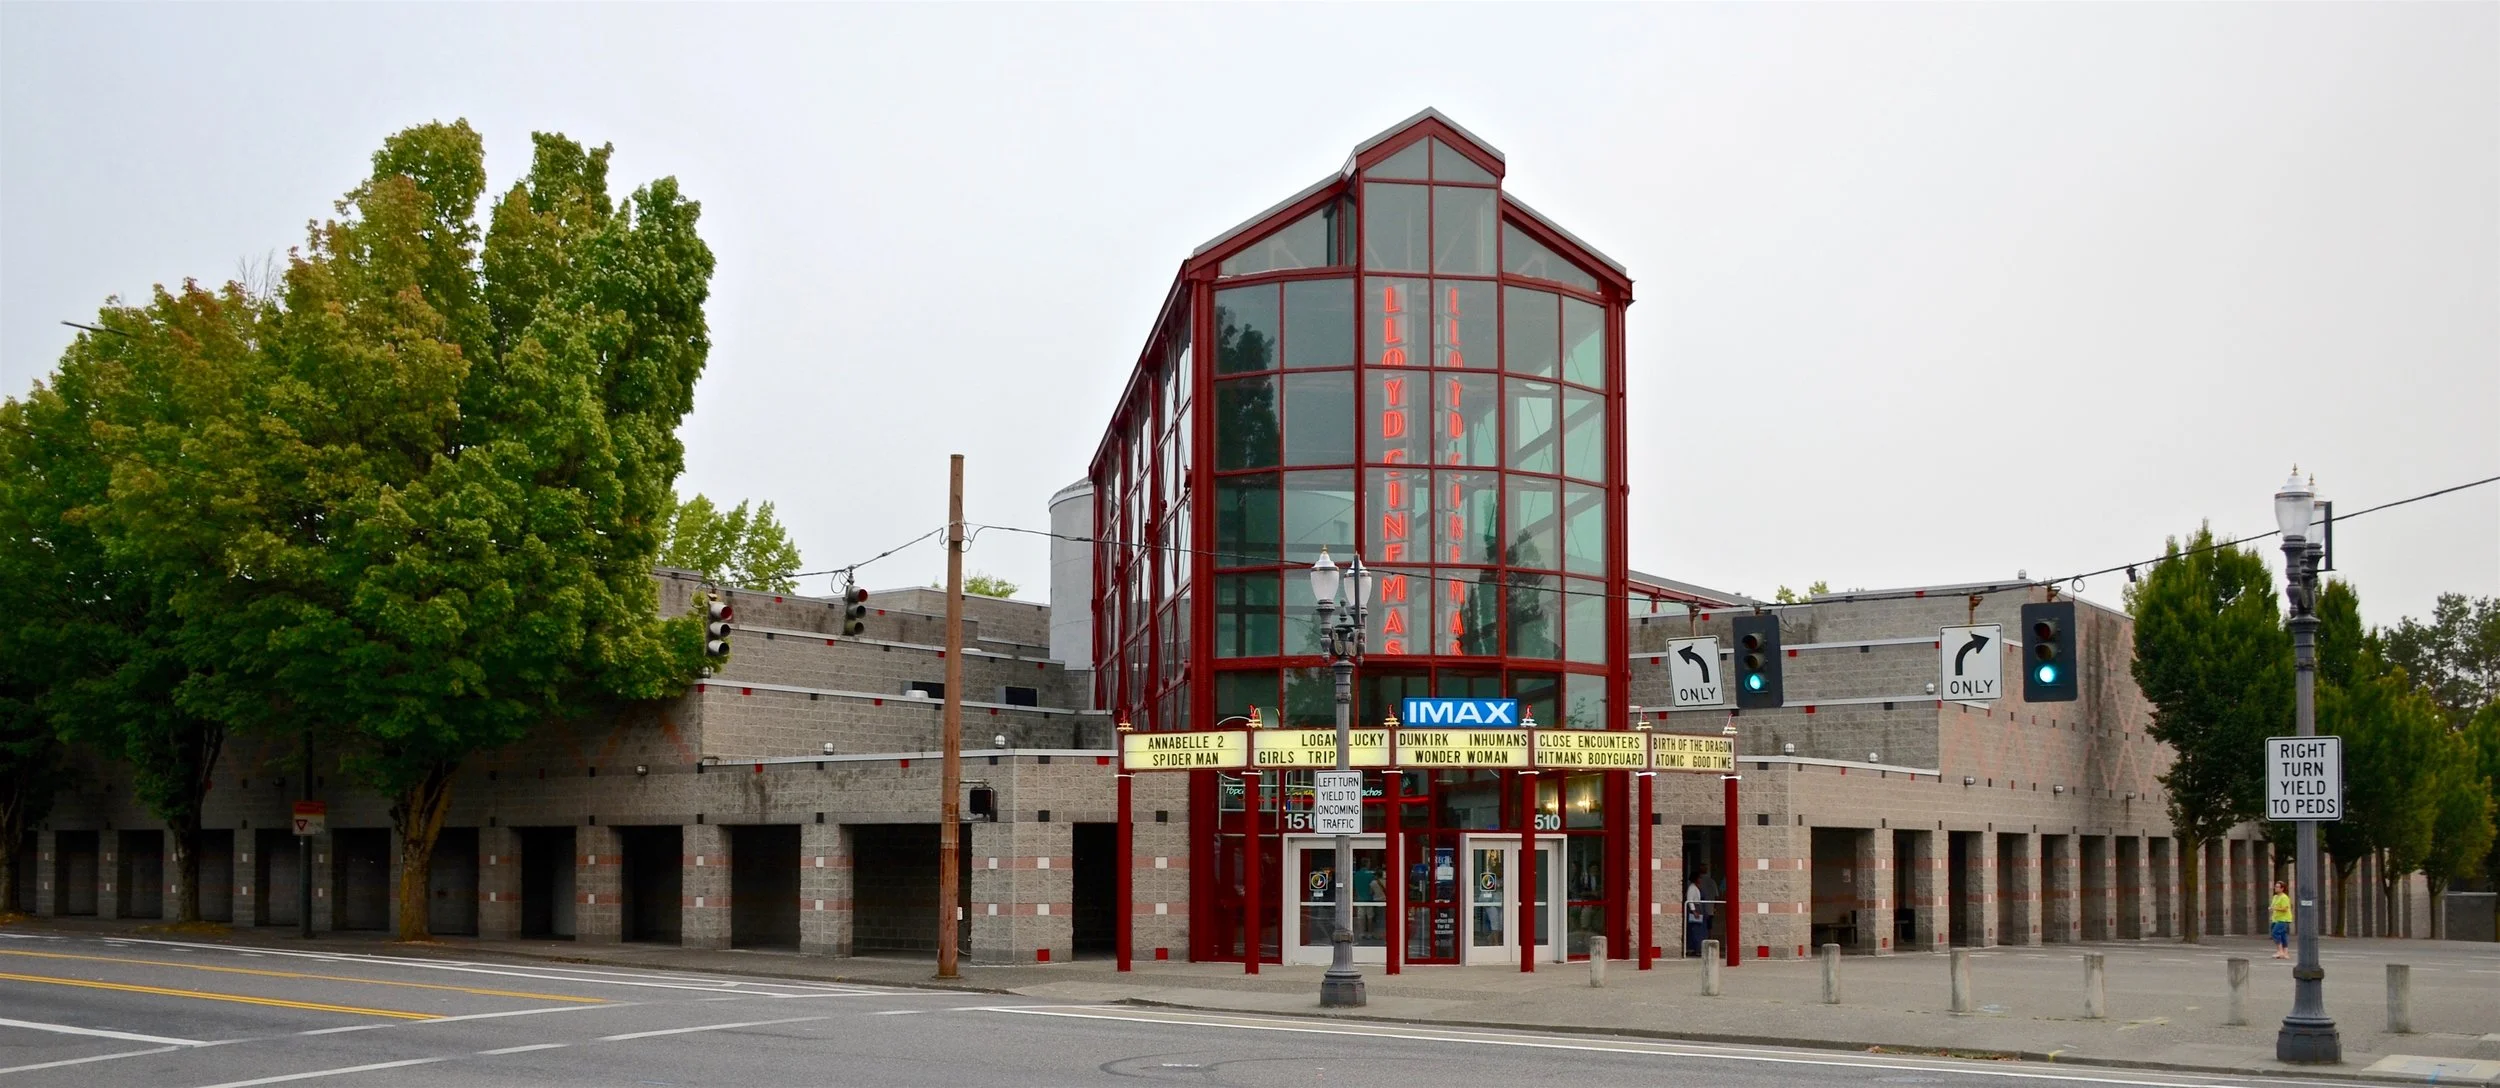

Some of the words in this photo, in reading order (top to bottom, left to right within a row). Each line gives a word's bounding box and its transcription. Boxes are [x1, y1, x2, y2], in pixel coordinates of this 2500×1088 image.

[1382, 286, 1406, 440] LLOYD
[1679, 687, 1716, 702] ONLY
[1950, 679, 1995, 696] ONLY
[1409, 701, 1514, 724] IMAX
[1148, 735, 1210, 750] ANNABELLE
[1217, 735, 1224, 748] 2
[1349, 733, 1385, 747] UCKY
[1399, 732, 1449, 746] DUNKIRK
[1469, 733, 1528, 747] INHUMANS
[1539, 734, 1572, 748] CLOSE
[1578, 735, 1641, 749] ENCOUNTERS
[1653, 737, 1676, 751] BIRTH
[1678, 738, 1688, 751] OF
[1690, 739, 1703, 752] THE
[1705, 740, 1733, 753] DRAGON
[1259, 750, 1295, 764] GIRLS
[1308, 750, 1336, 764] TRIP
[1414, 750, 1461, 764] WONDER
[1466, 750, 1508, 764] WOMAN
[1537, 751, 1583, 765] HITMANS
[1588, 752, 1644, 766] BODYGUARD
[2280, 743, 2326, 759] RIGHT
[1152, 752, 1192, 767] SPIDER
[1195, 752, 1219, 766] MAN
[1655, 753, 1685, 767] ATOMIC
[1692, 755, 1711, 768] GOOD
[1713, 756, 1732, 770] TIME
[2282, 761, 2324, 777] TURN
[1318, 777, 1338, 788] LEFT
[1339, 777, 1359, 787] TURN
[2280, 780, 2326, 796] YIELD
[1321, 791, 1344, 801] YIELD
[1346, 791, 1356, 801] TO
[1361, 787, 1383, 797] achos
[1318, 804, 1359, 815] ONCOMING
[2271, 799, 2290, 814] TO
[2295, 798, 2336, 814] PEDS
[1284, 813, 1316, 830] 151
[1322, 818, 1354, 829] TRAFFIC
[1534, 813, 1561, 831] 510
